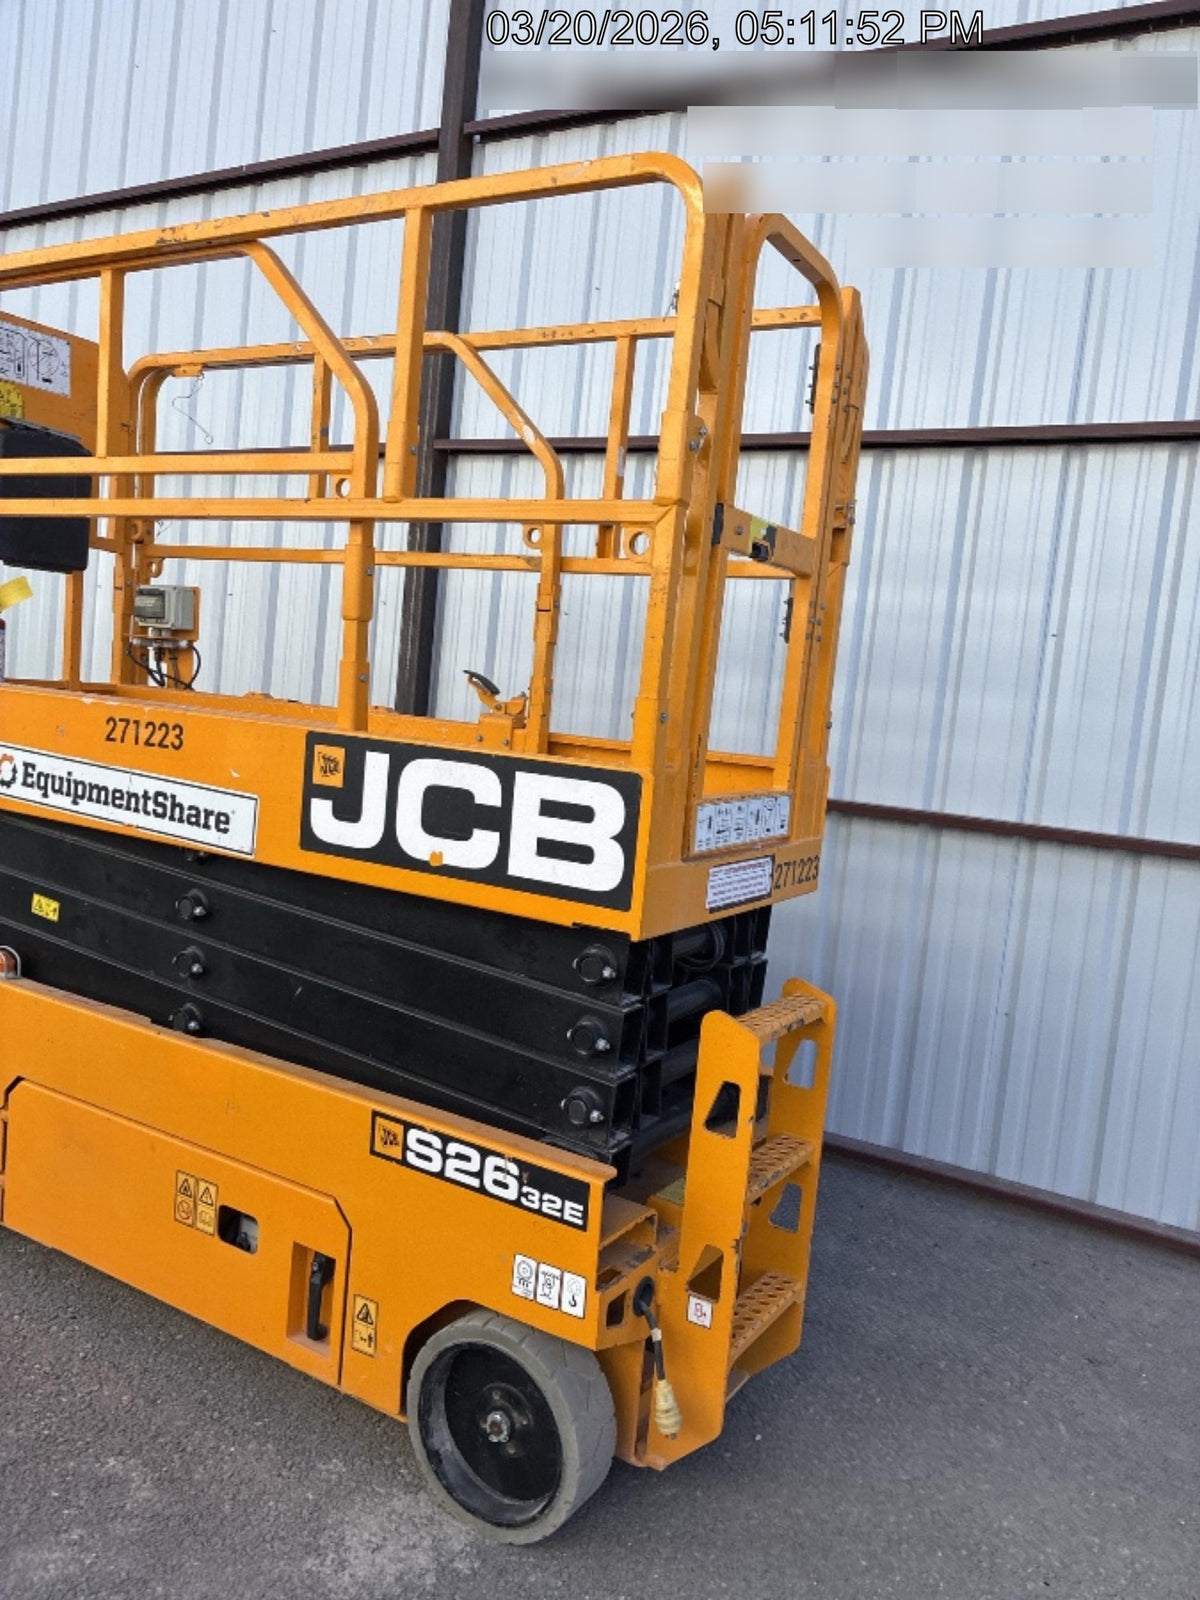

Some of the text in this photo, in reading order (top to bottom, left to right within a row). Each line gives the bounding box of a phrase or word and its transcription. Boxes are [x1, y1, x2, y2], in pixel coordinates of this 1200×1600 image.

[105, 716, 184, 750] 271223
[21, 762, 231, 834] EquipmentShare
[310, 750, 625, 892] JCB
[773, 855, 820, 889] 271223
